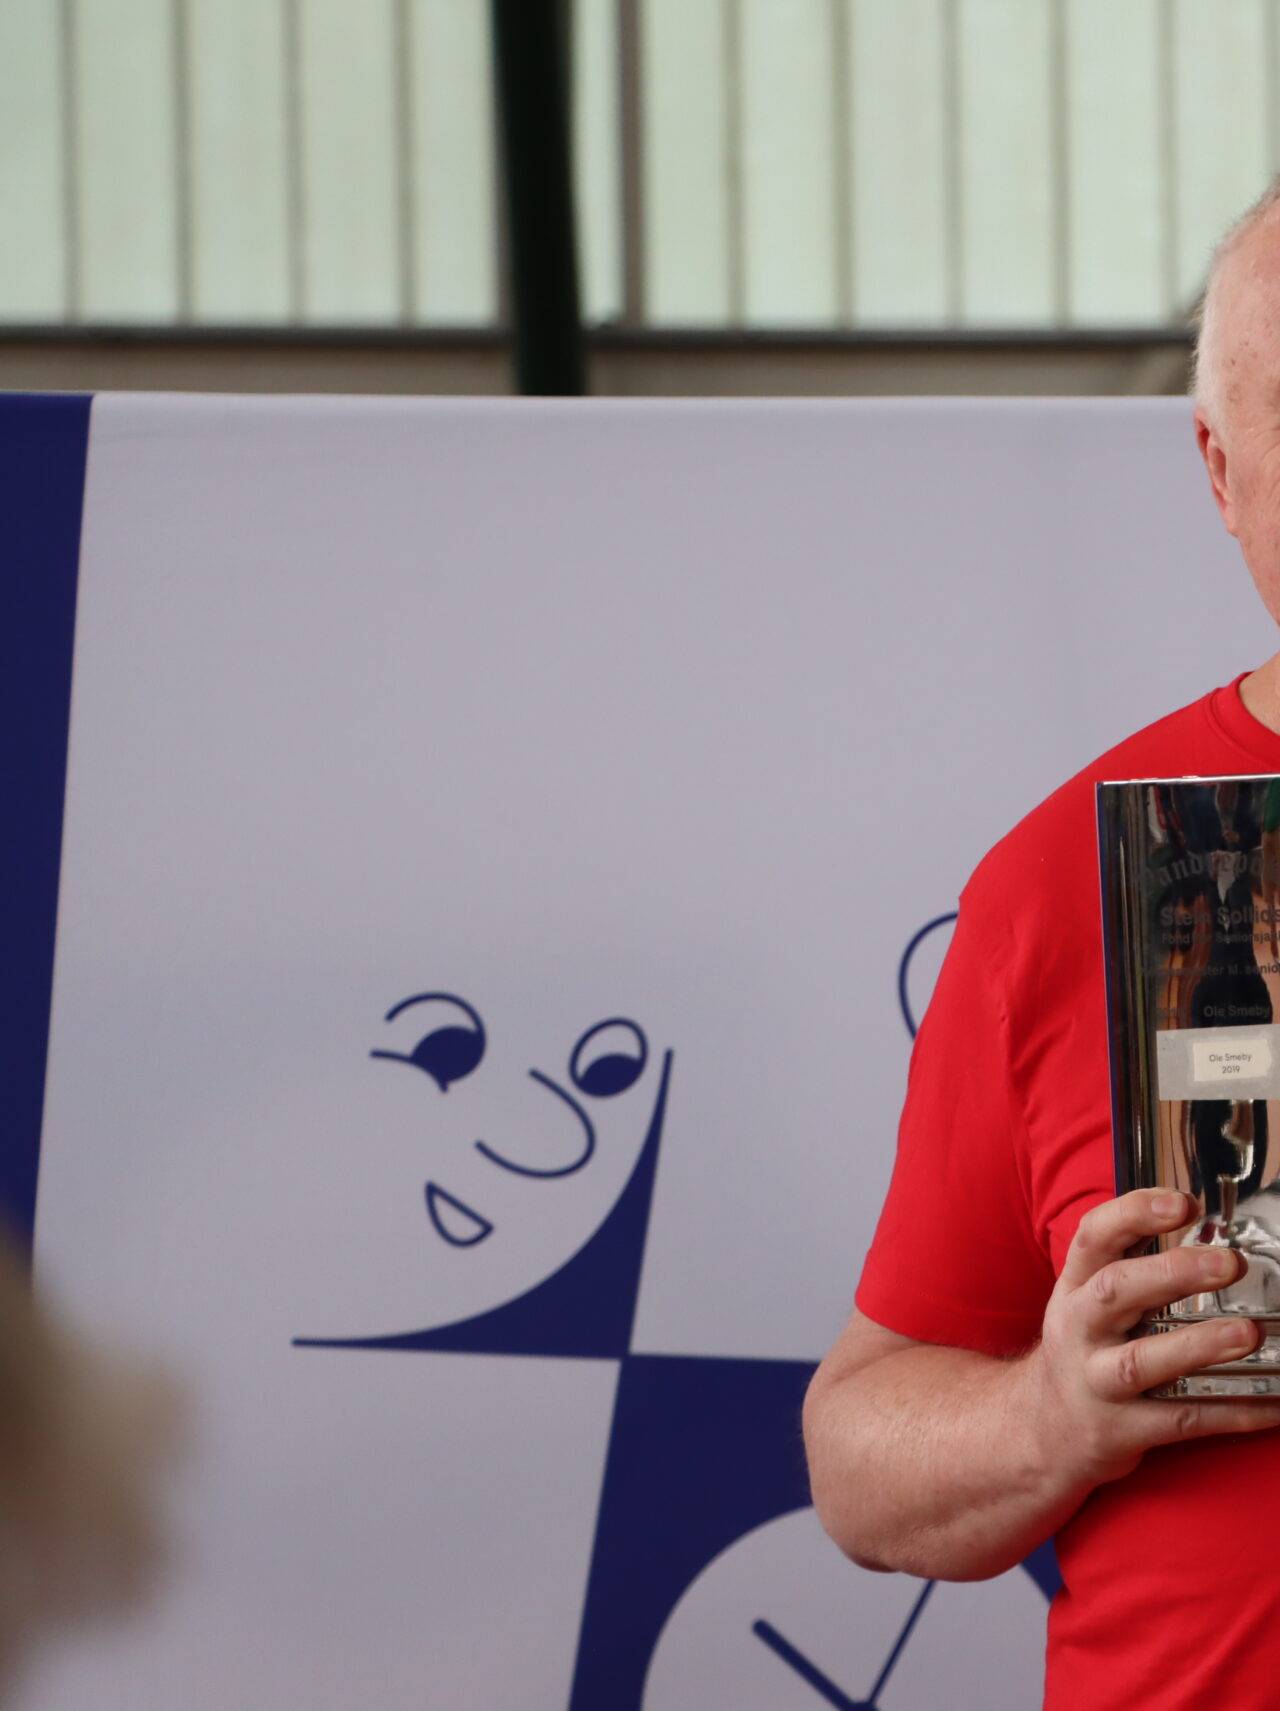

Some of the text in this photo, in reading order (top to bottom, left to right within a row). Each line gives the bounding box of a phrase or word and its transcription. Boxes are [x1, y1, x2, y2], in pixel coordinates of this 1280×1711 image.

[1203, 1005, 1225, 1018] Ole
[1229, 1004, 1271, 1018] Smeby
[1209, 1052, 1252, 1063] Ole Smeby
[1221, 1065, 1241, 1075] 2019
